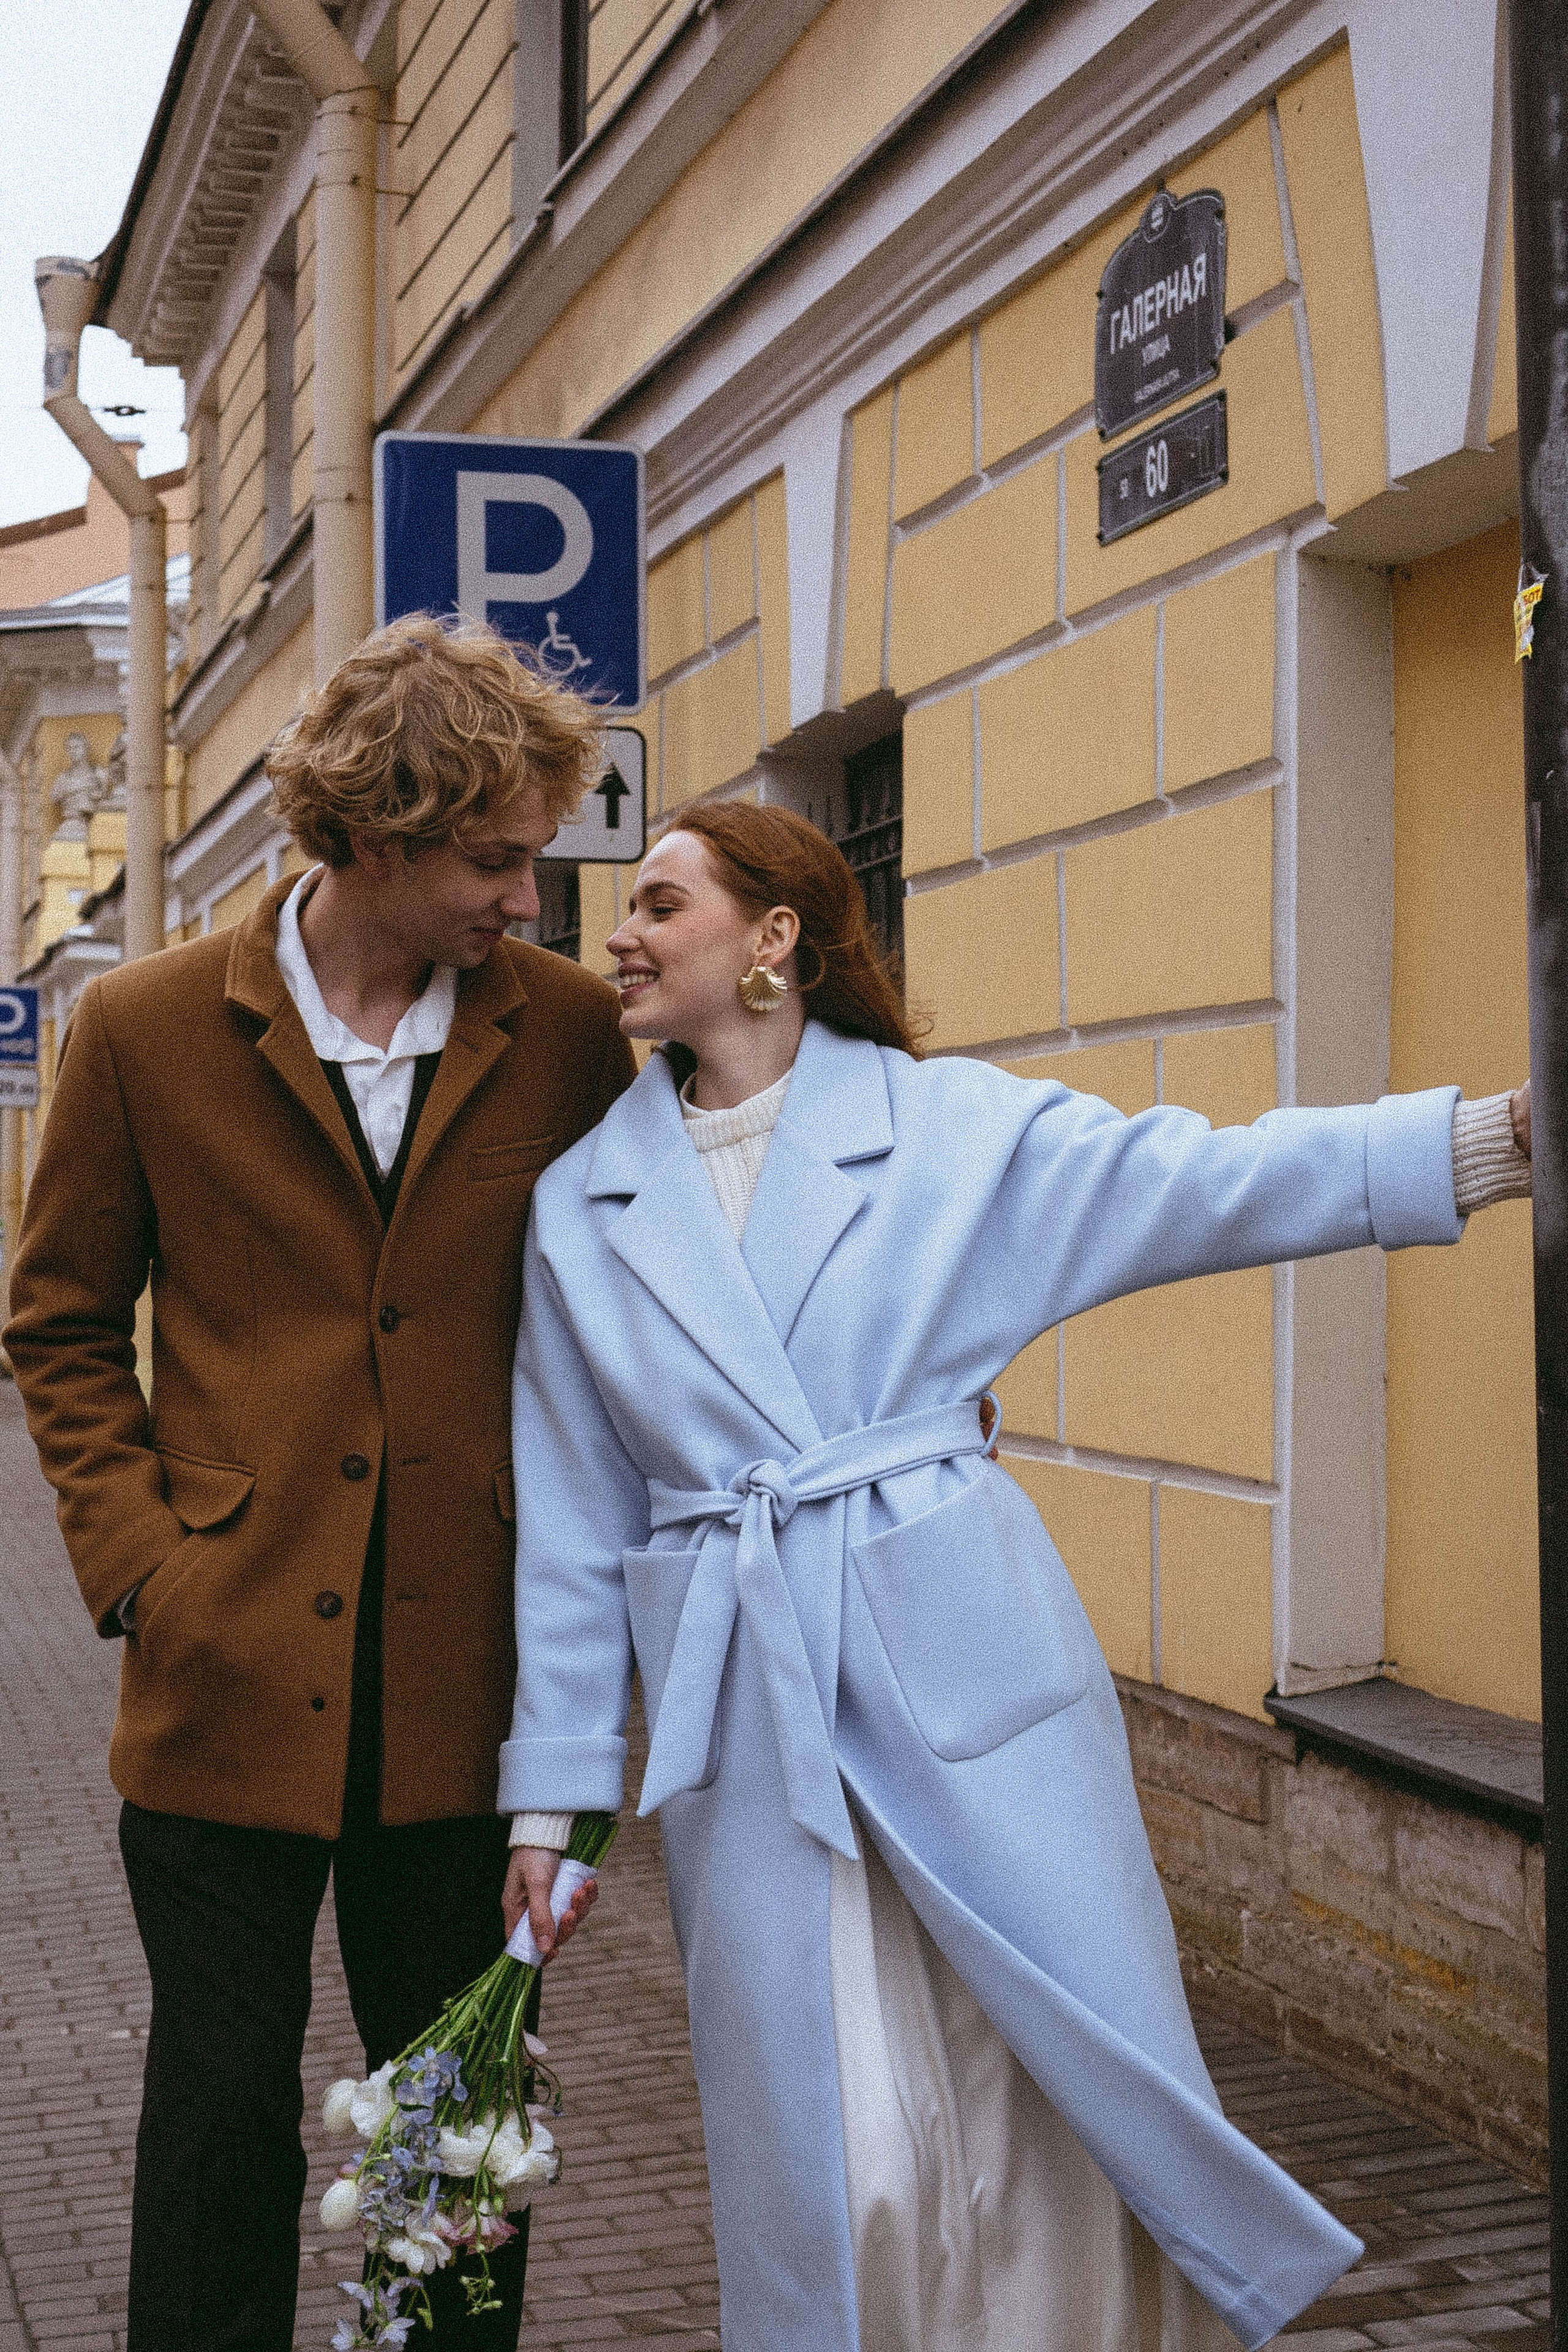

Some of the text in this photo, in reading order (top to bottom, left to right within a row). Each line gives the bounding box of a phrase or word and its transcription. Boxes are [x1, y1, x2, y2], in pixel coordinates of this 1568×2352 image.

[1110, 252, 1207, 355] ГАЛЕРНАЯ
[1145, 439, 1169, 498] 60
[456, 470, 594, 632] P
